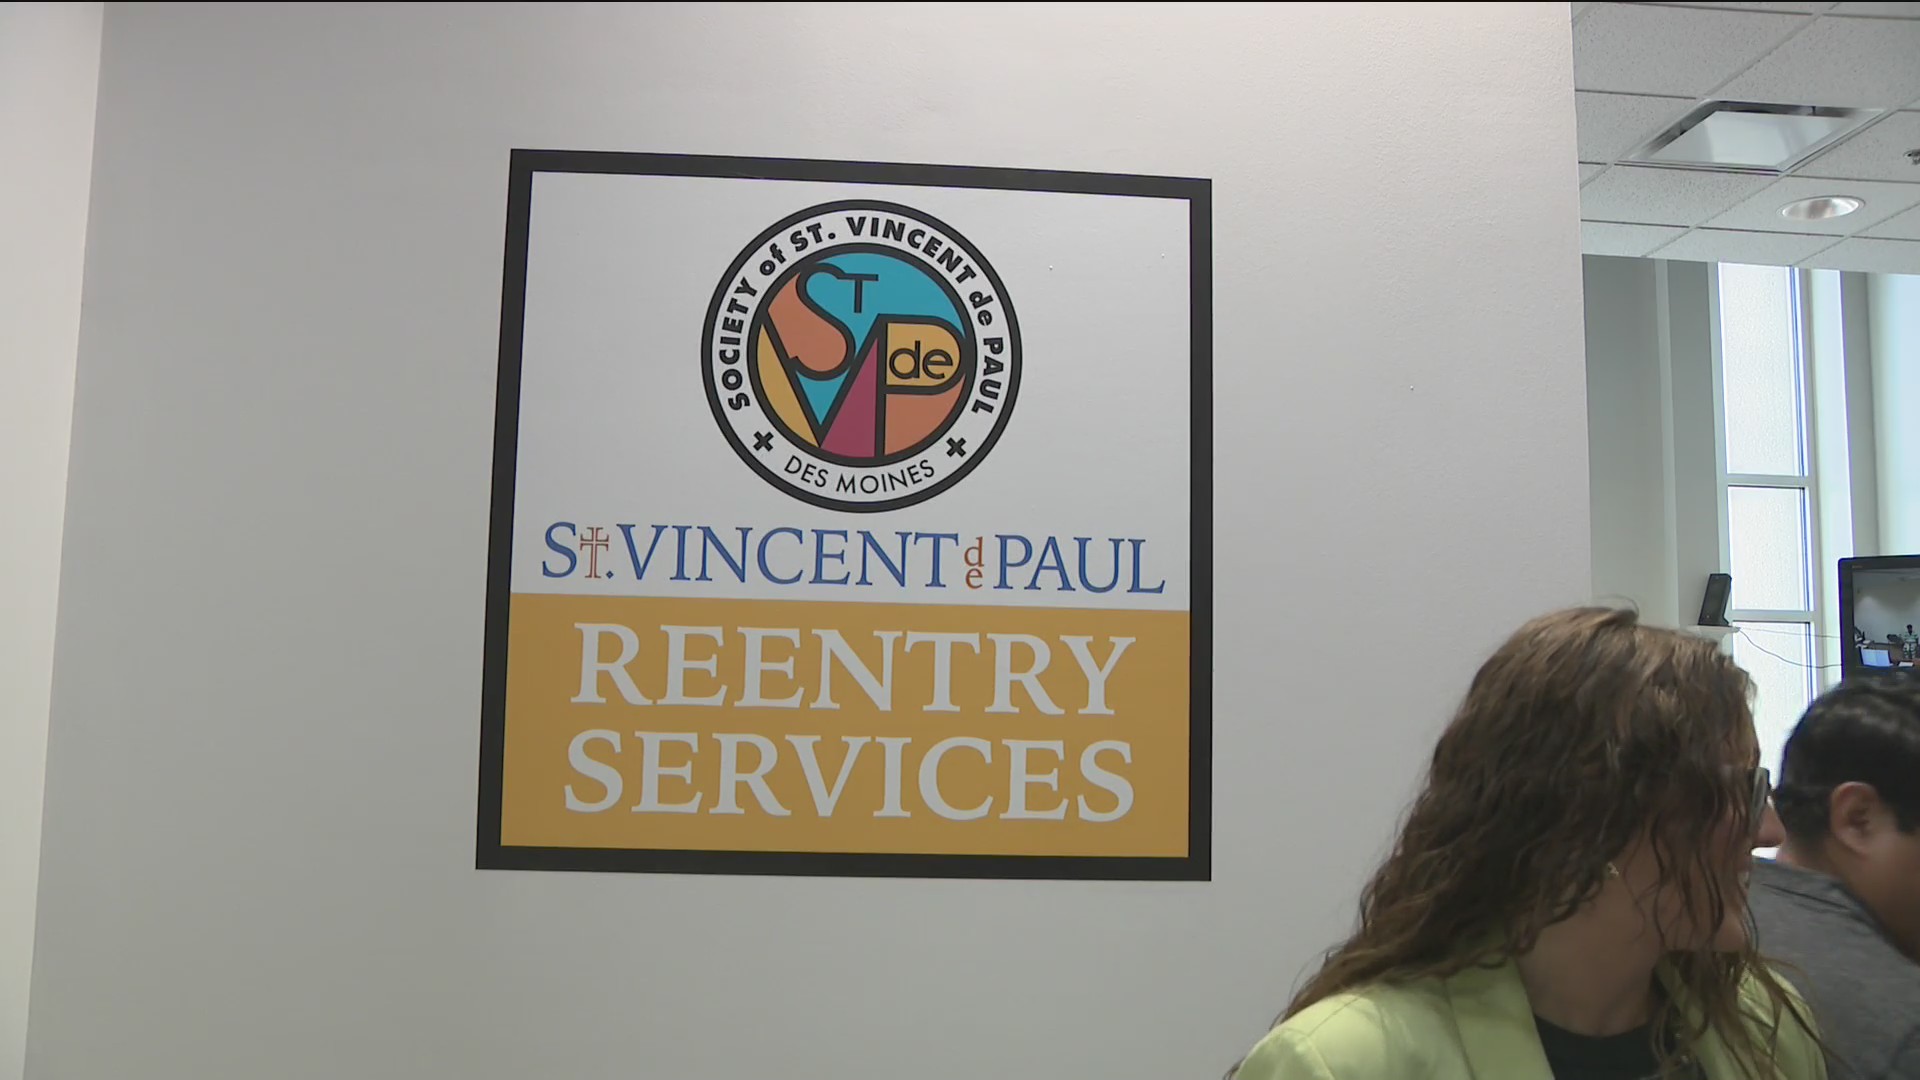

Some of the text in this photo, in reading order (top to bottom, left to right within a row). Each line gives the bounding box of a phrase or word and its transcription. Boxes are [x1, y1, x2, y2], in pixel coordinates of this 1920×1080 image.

[719, 216, 1004, 414] SOCIETY of ST. VINCENT de PAUL
[889, 340, 954, 380] de
[784, 455, 935, 494] DES MOINES
[616, 523, 959, 588] VINCENT
[993, 535, 1166, 594] PAUL
[570, 622, 1136, 716] REENTRY
[564, 728, 1135, 822] SERVICES
